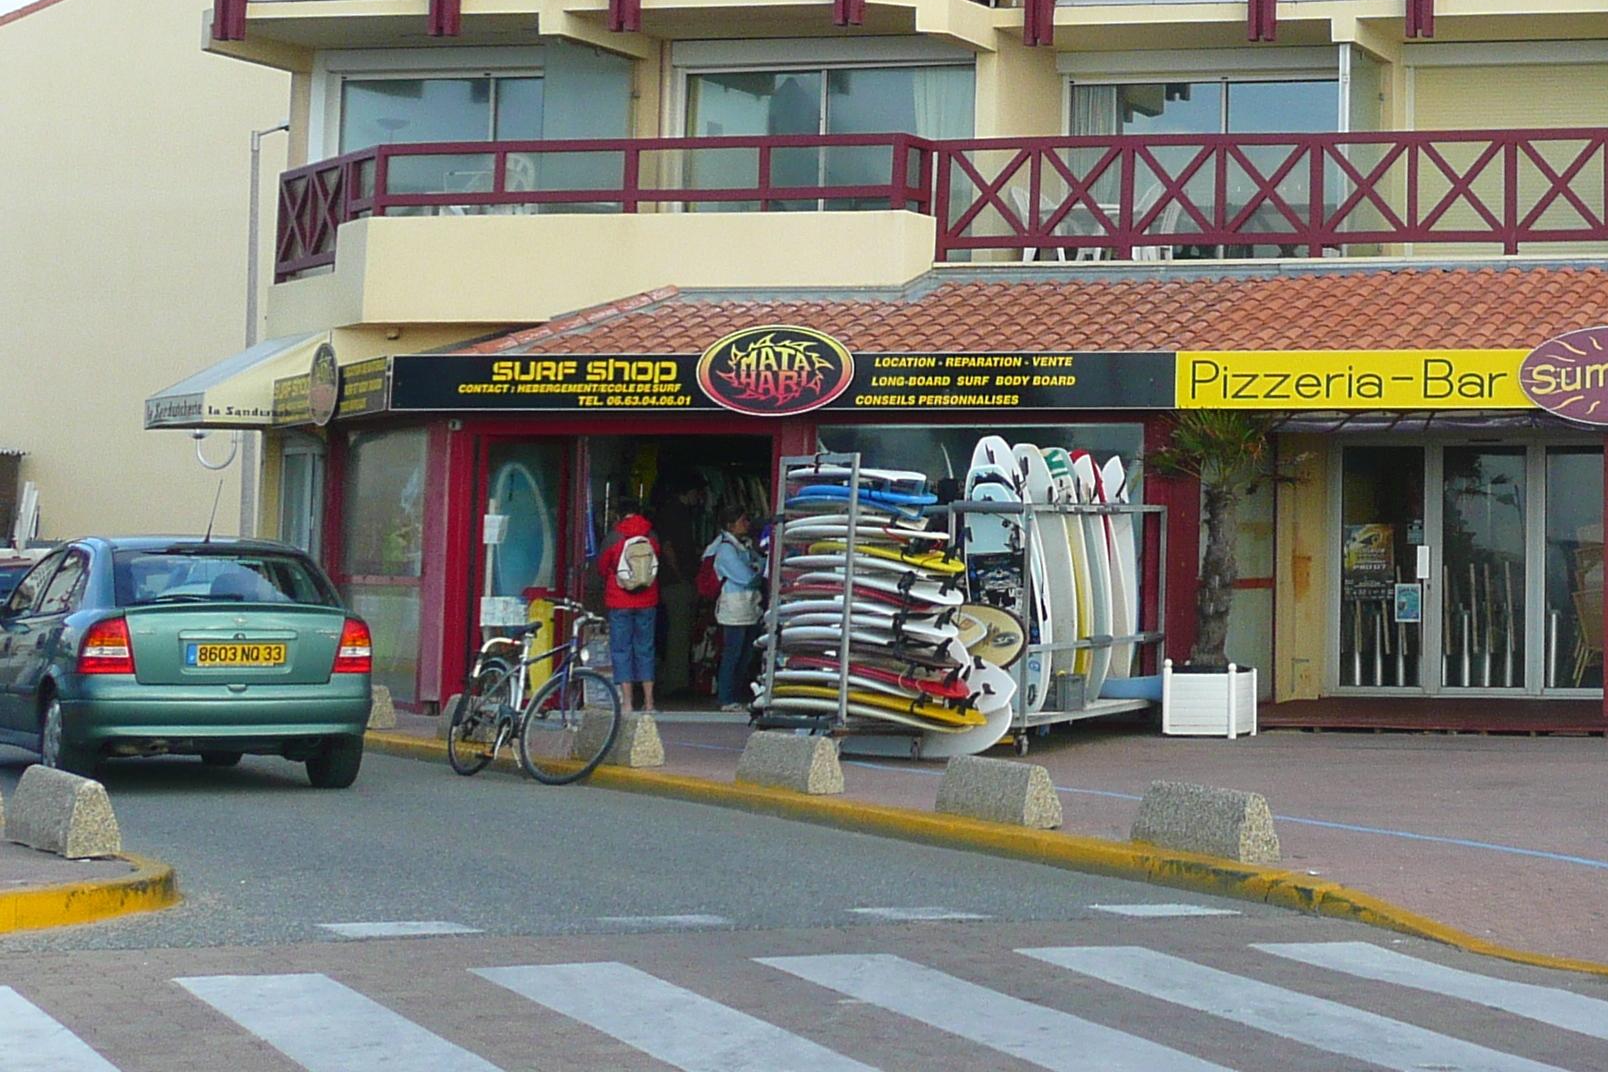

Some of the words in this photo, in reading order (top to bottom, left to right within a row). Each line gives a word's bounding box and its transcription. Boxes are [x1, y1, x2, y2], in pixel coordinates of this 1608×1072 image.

[738, 344, 813, 371] MATA
[874, 357, 937, 368] LOCATION
[945, 357, 1023, 368] REPARATION
[1032, 356, 1073, 367] VENTE
[492, 361, 578, 382] SURF
[738, 370, 810, 396] HARI
[956, 376, 990, 387] SURF
[995, 375, 1030, 387] BODY
[1032, 375, 1077, 387] BOARD
[458, 383, 510, 394] CONTACT
[637, 383, 652, 394] DE
[652, 383, 682, 393] SURF
[578, 396, 604, 407] TEL.
[855, 395, 917, 406] CONSEILS
[918, 394, 1020, 406] PERSONNALISES
[198, 646, 237, 662] 8603
[264, 646, 282, 661] 33
